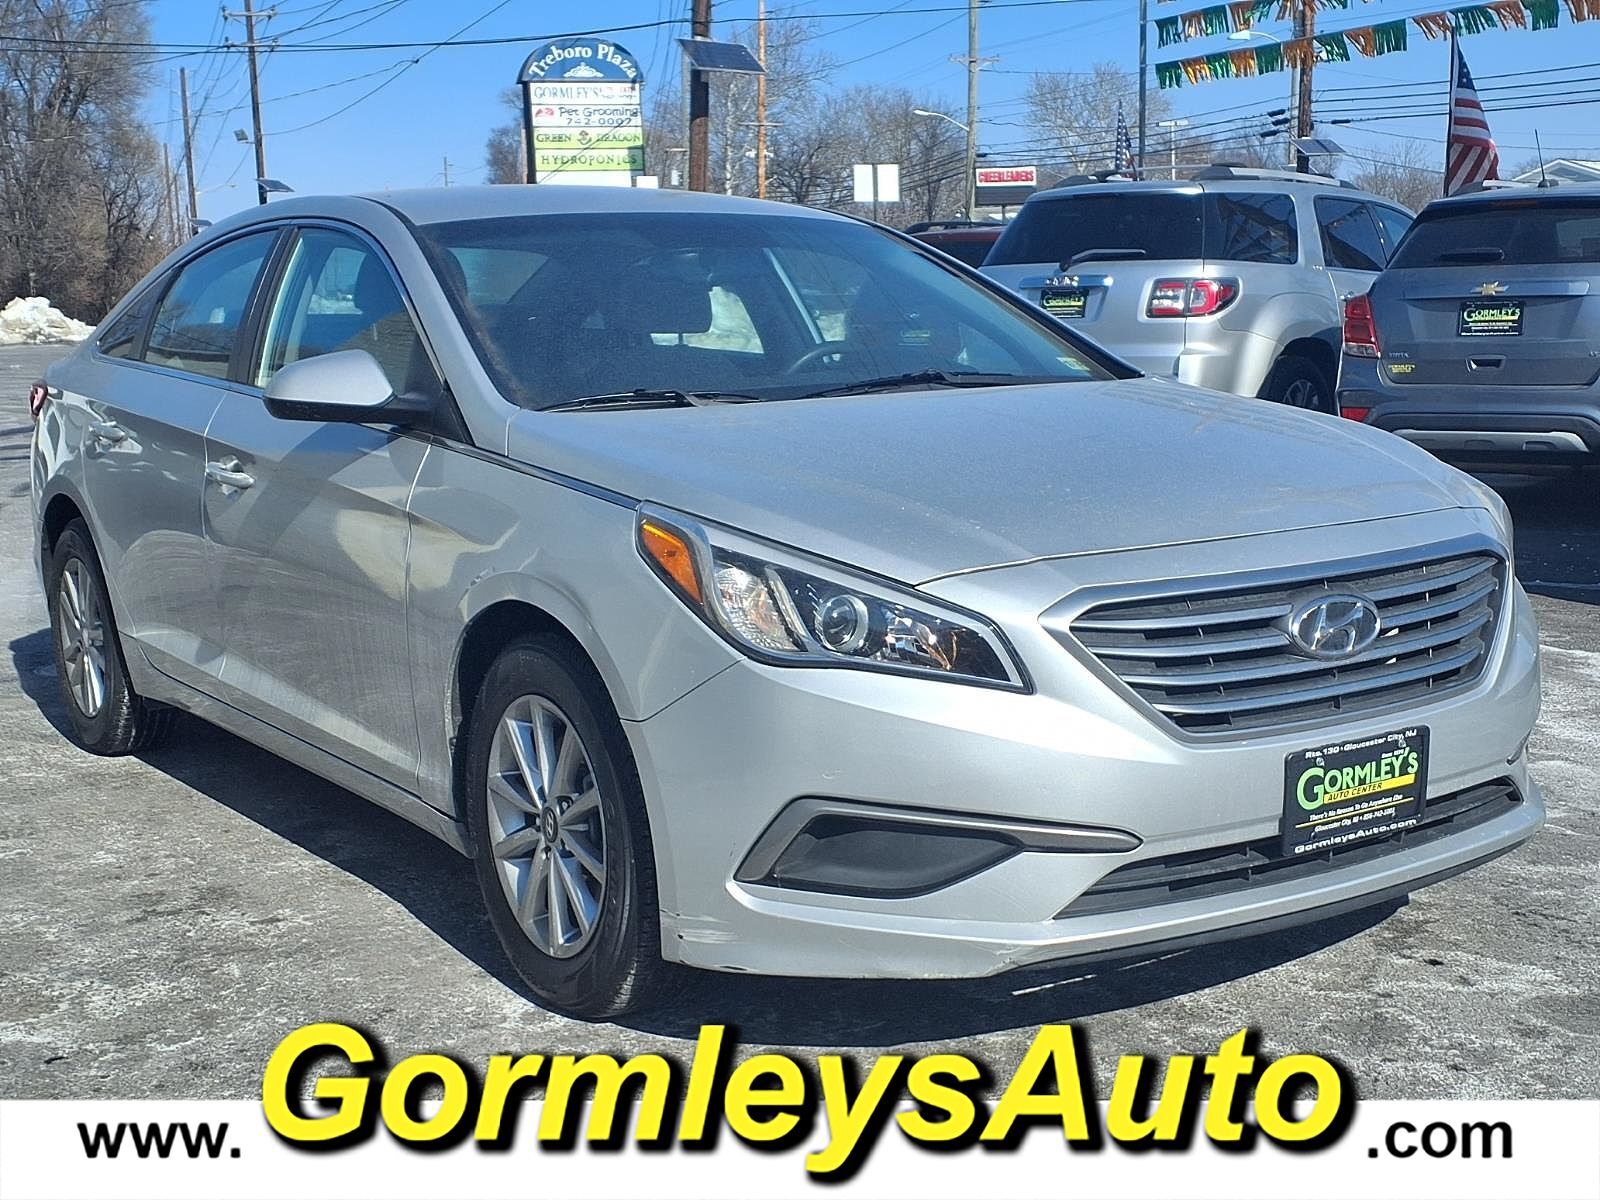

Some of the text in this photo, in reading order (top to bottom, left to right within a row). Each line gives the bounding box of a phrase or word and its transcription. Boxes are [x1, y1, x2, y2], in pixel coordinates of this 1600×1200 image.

[528, 43, 638, 79] Treboro Plaza
[558, 106, 639, 118] Pet Grooming
[536, 133, 572, 143] GREEN
[541, 154, 638, 166] HYDROPONICS
[1463, 307, 1521, 321] GORMLEY'S
[1323, 746, 1340, 755] 130
[1344, 738, 1386, 751] Gloucester
[1405, 728, 1417, 737] NJ
[1297, 747, 1419, 810] GORMLEY'S
[1328, 783, 1383, 801] AUTO CENTER
[1295, 819, 1417, 853] GormleysAuto.com
